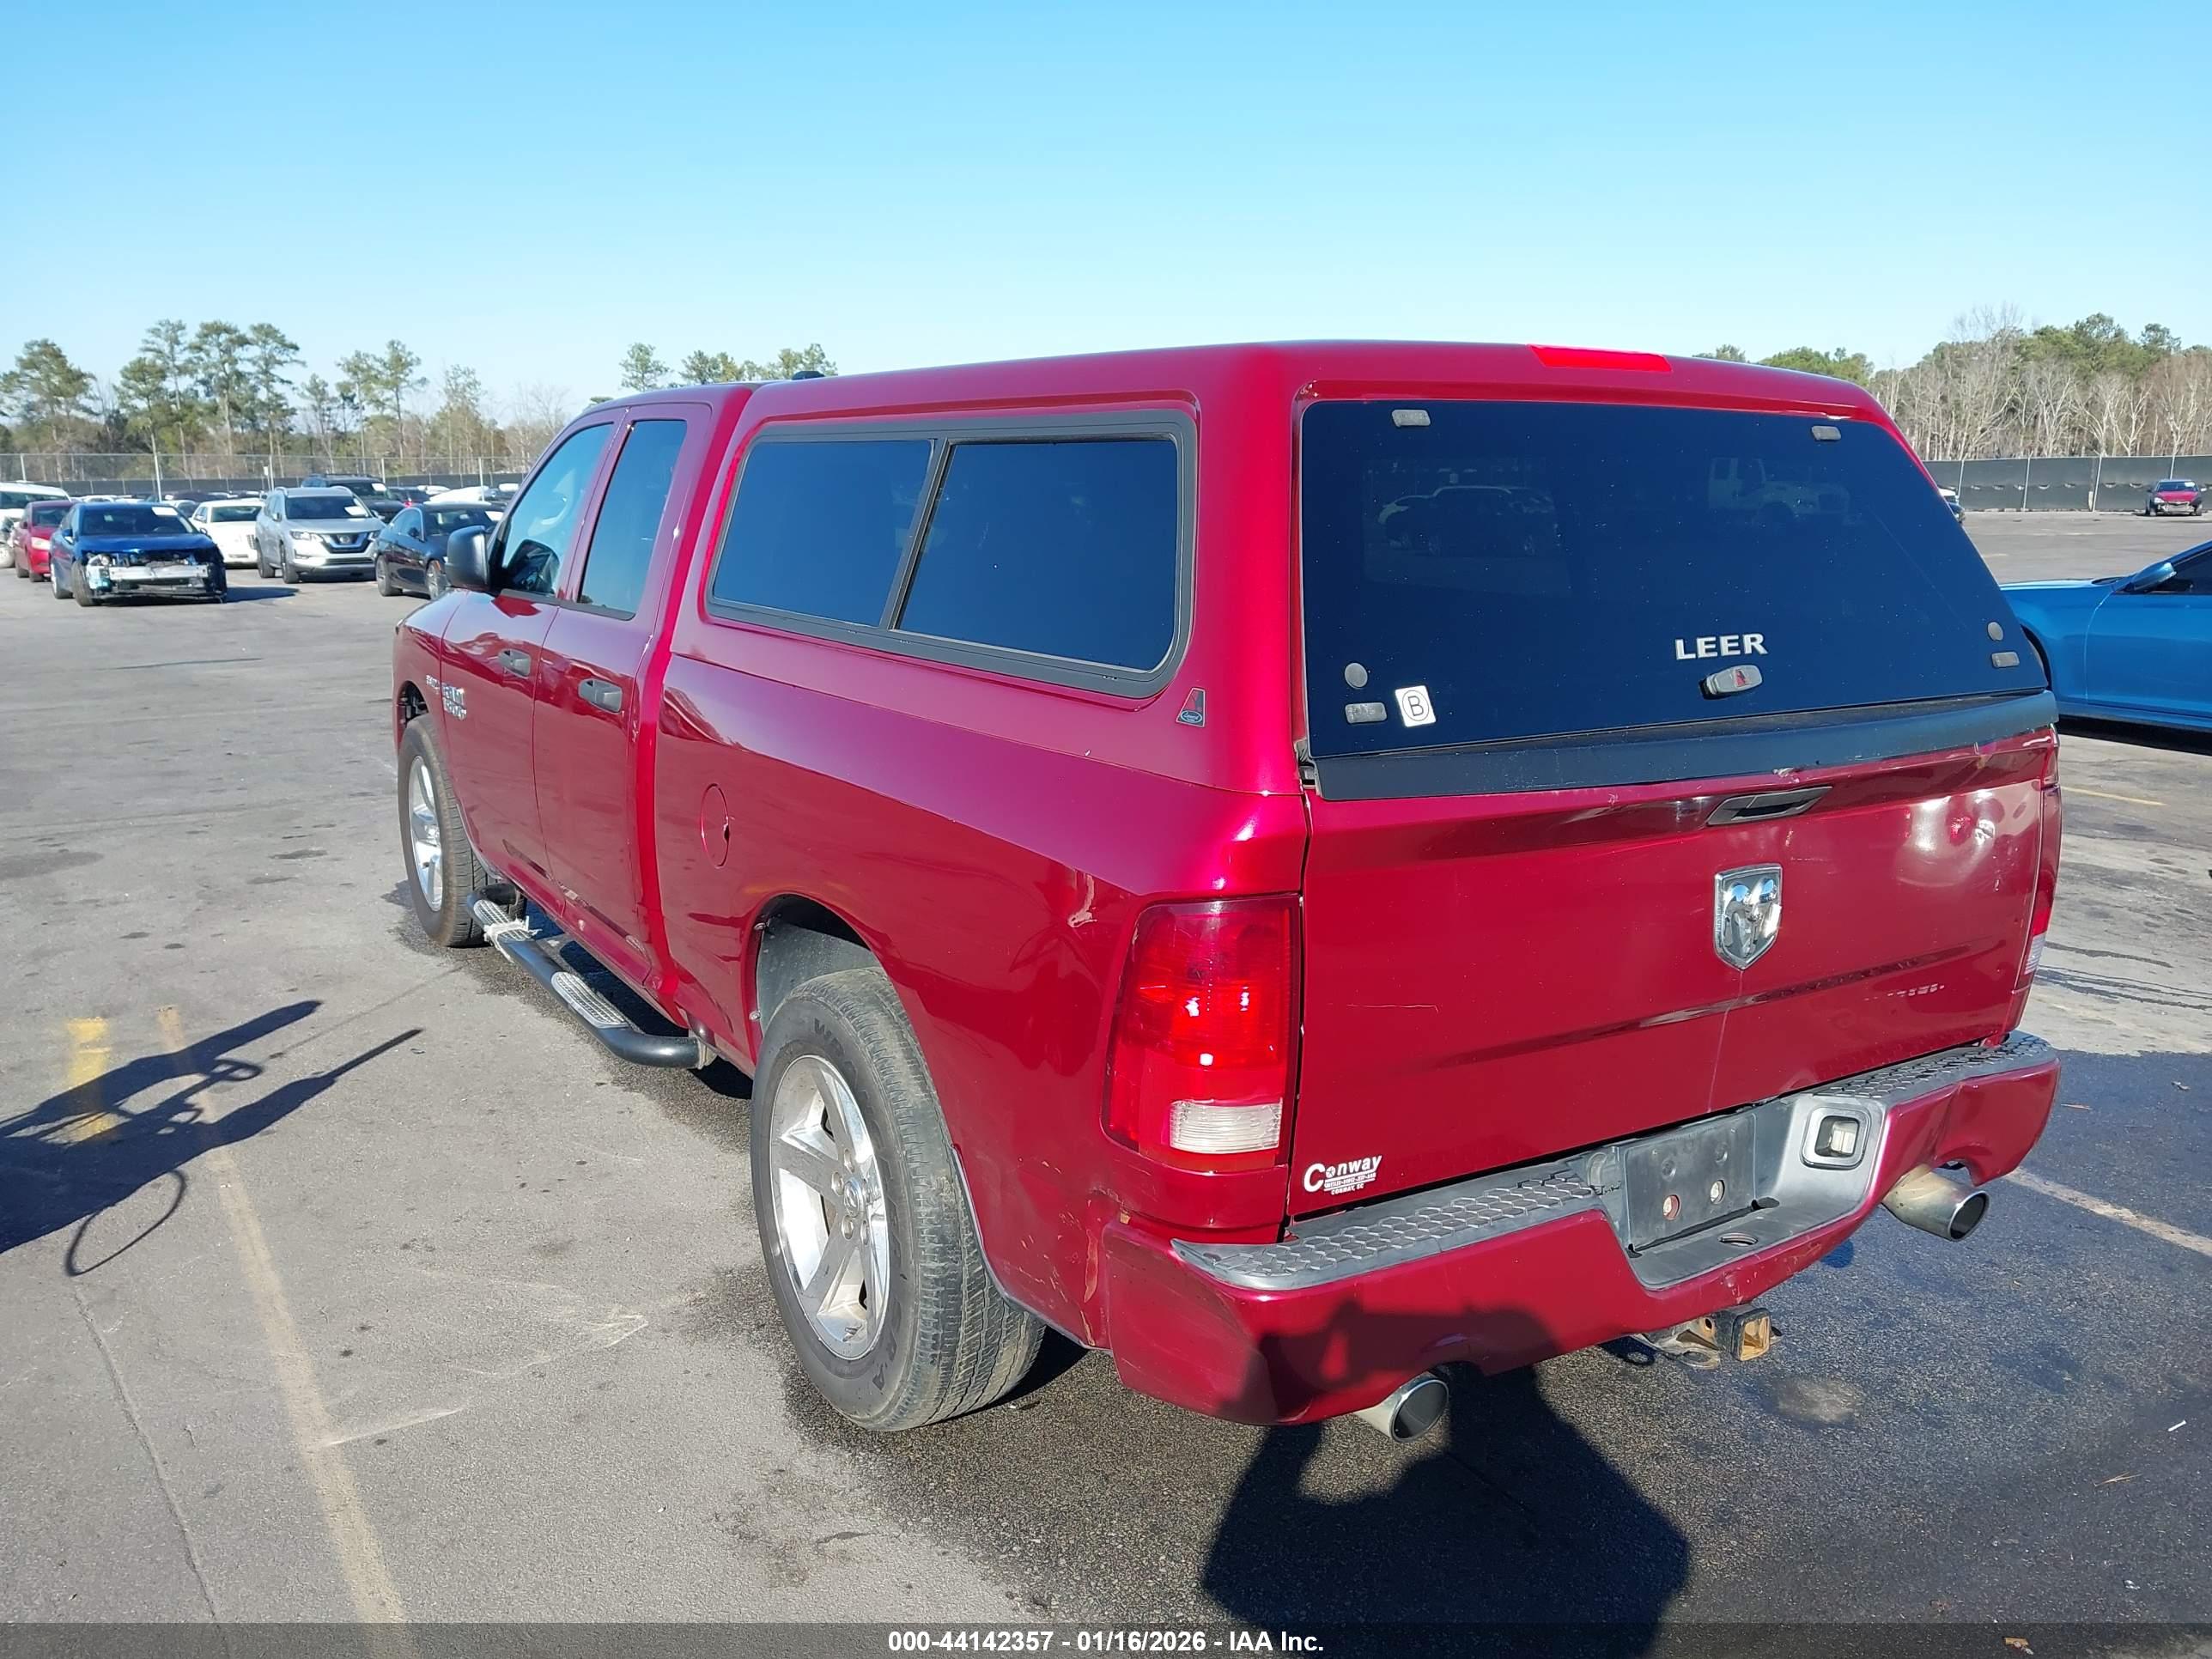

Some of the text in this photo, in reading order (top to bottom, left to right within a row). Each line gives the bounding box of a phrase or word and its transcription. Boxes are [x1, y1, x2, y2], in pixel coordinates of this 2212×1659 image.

[1675, 633, 1768, 660] LEER
[1408, 696, 1424, 716] B
[1304, 1155, 1382, 1193] Conway
